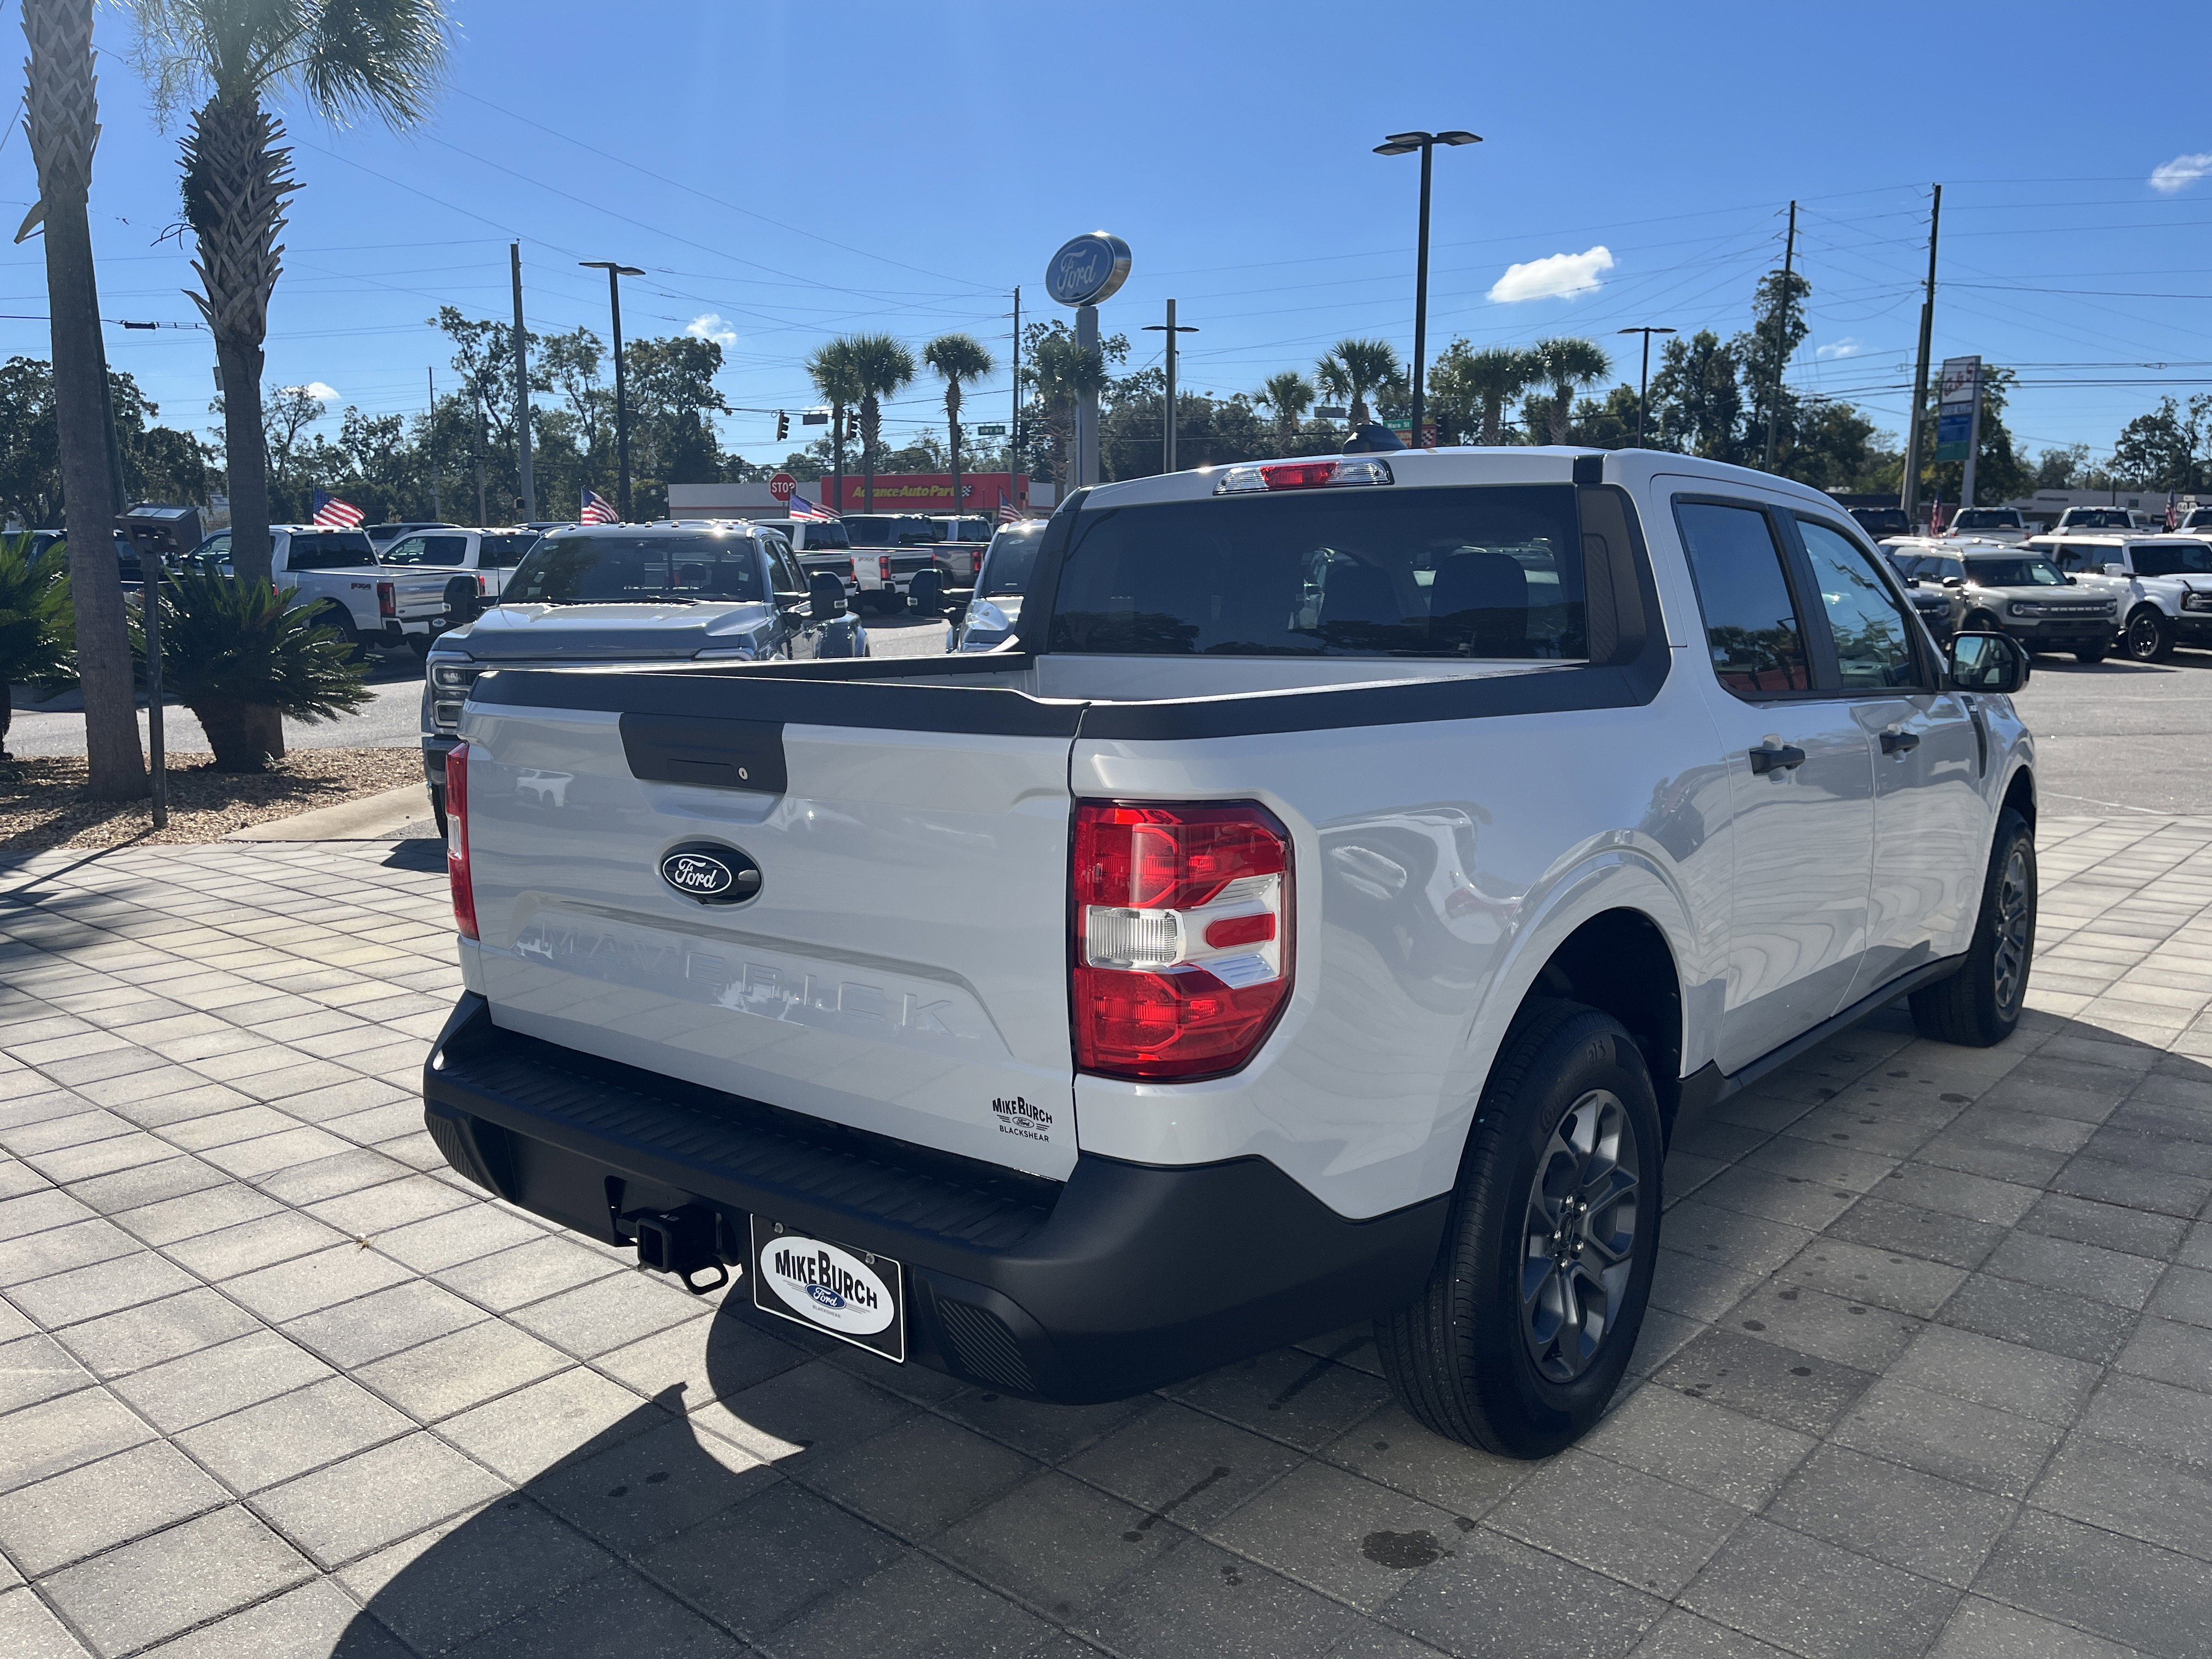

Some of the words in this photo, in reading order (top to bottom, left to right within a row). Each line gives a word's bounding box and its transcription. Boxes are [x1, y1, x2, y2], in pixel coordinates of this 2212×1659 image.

[1057, 249, 1098, 292] Ford
[771, 482, 795, 493] STOP
[899, 485, 929, 497] Auto
[929, 485, 955, 496] Part
[674, 858, 718, 889] Ford
[539, 921, 953, 1037] MAVERICK
[1016, 1118, 1030, 1127] Ford
[999, 1125, 1049, 1143] BLACKSHEAR
[812, 1286, 838, 1307] Ford
[812, 1304, 841, 1318] BLACKSHEAR
